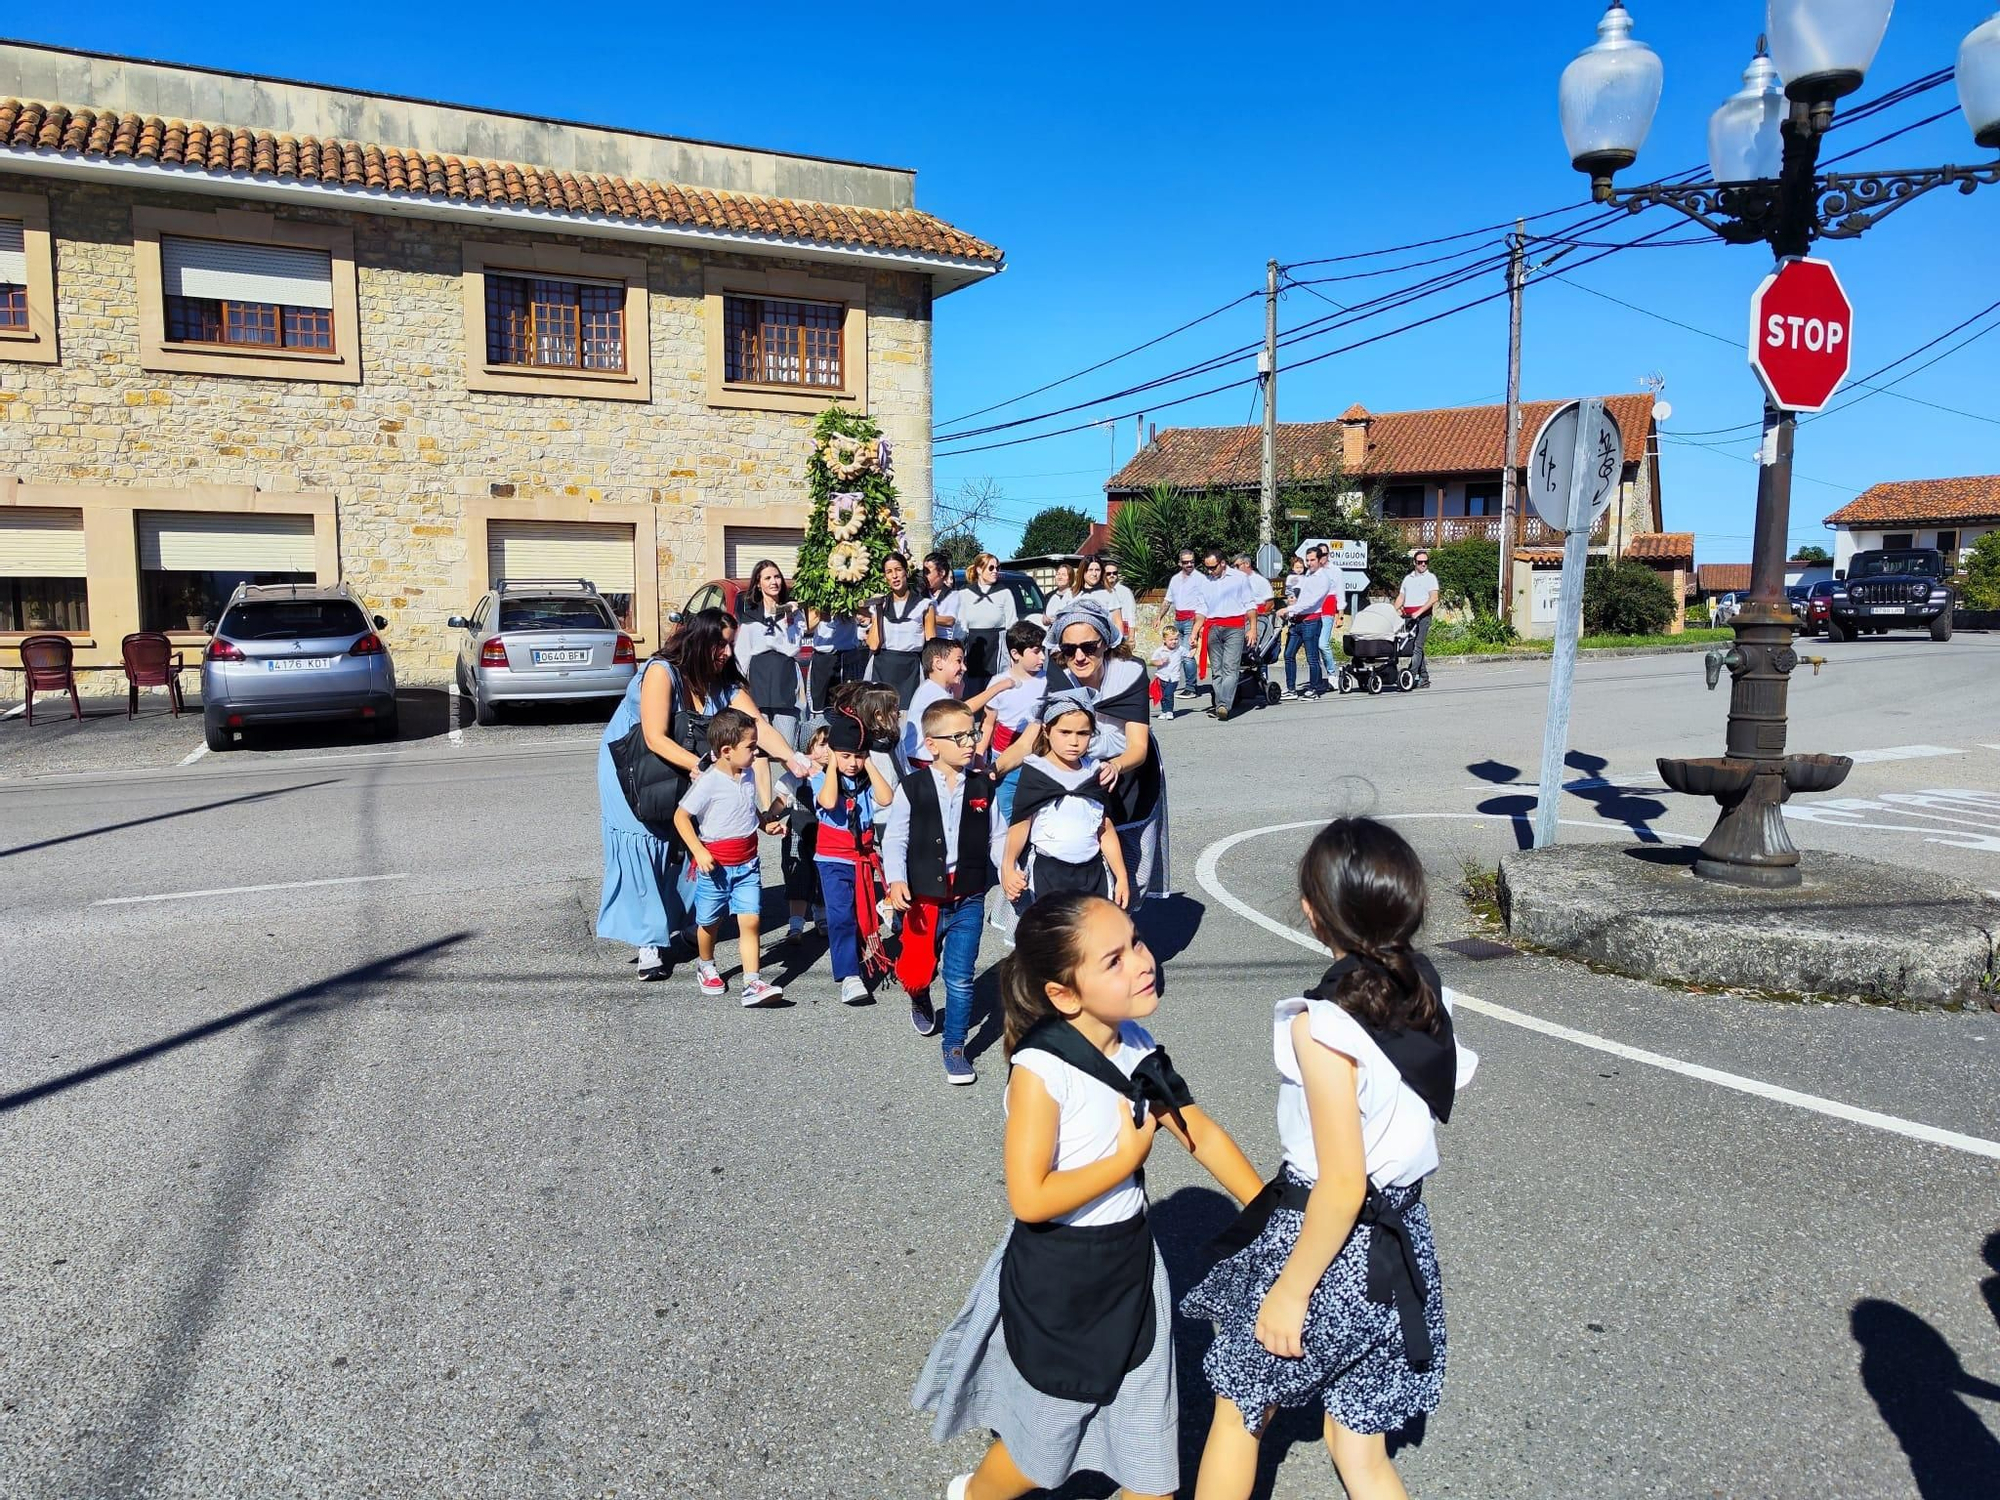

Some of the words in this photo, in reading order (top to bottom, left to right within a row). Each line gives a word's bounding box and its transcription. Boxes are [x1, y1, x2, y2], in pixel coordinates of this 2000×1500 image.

[1766, 313, 1844, 354] STOP
[541, 652, 566, 661] 0640
[274, 660, 302, 669] 4176
